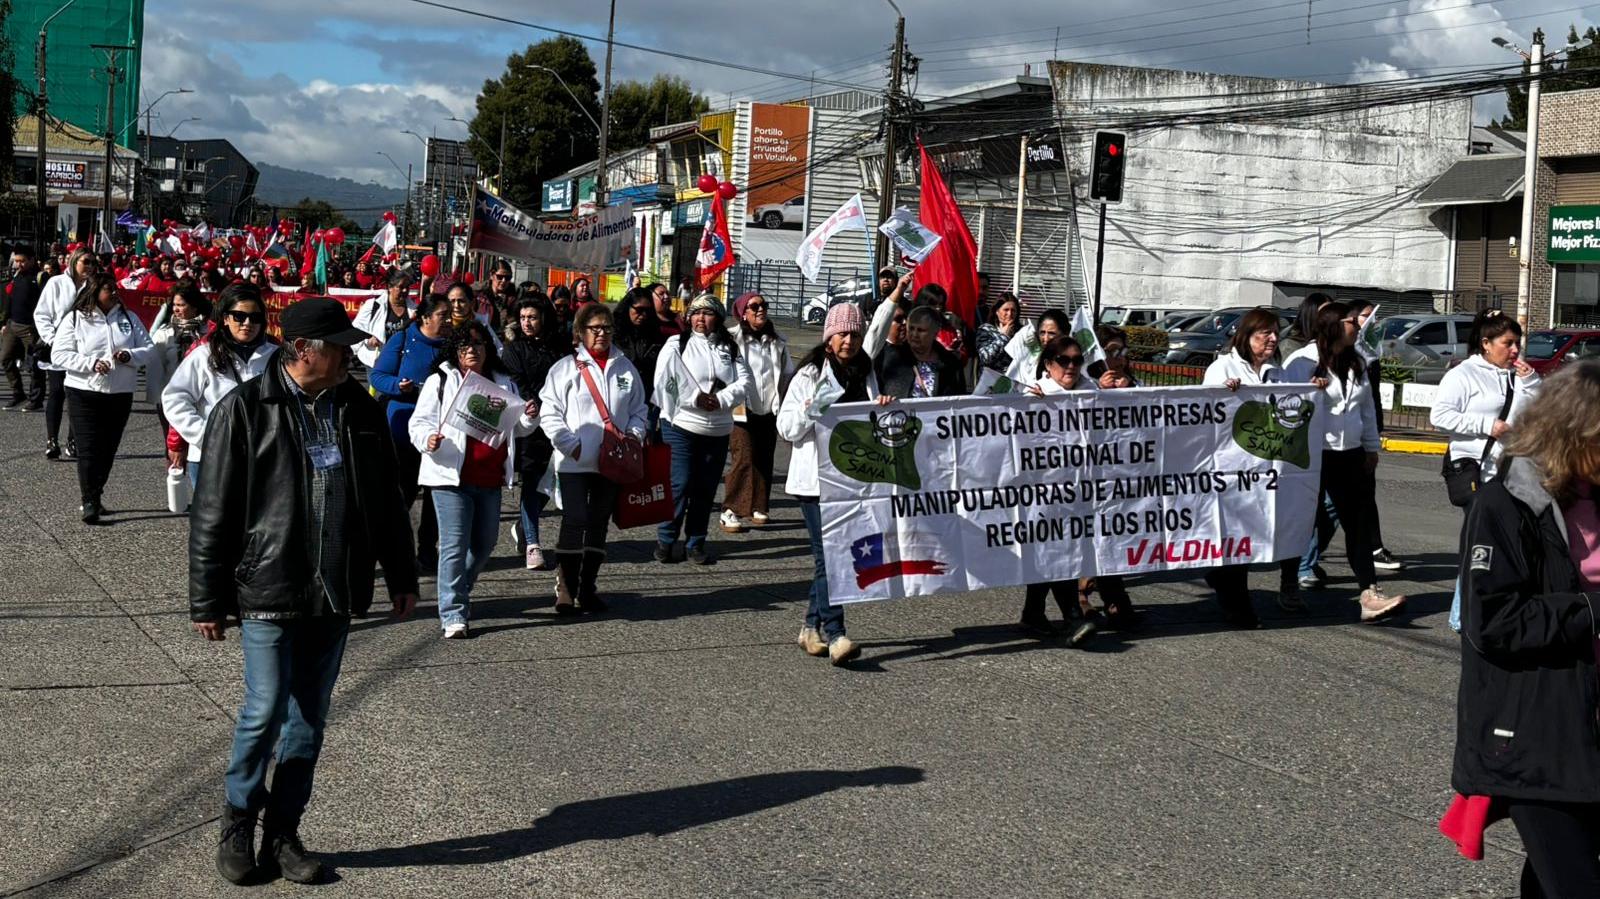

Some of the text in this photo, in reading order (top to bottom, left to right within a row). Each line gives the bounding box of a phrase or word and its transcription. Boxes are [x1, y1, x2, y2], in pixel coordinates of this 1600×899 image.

[754, 126, 783, 136] Portillo
[754, 136, 778, 144] ahora
[45, 162, 76, 172] HOSTAL
[490, 203, 574, 243] Manipuladoras
[577, 228, 589, 243] de
[1552, 216, 1594, 232] Mejores
[1551, 234, 1582, 251] Mejor
[936, 402, 1226, 440] SINDICATO INTEREMPRESAS
[839, 441, 897, 466] COCINA
[1021, 440, 1156, 471] REGIONAL DE
[1247, 436, 1283, 458] SANA
[846, 459, 886, 479] SANA
[891, 480, 1076, 519] MANIPULADORAS
[1081, 479, 1106, 502] DE
[1112, 471, 1227, 500] ALIMENTOS
[1266, 469, 1278, 490] 2
[1070, 516, 1094, 539] DE
[1101, 511, 1139, 537] LOS
[1126, 536, 1251, 566] VALDIVIA
